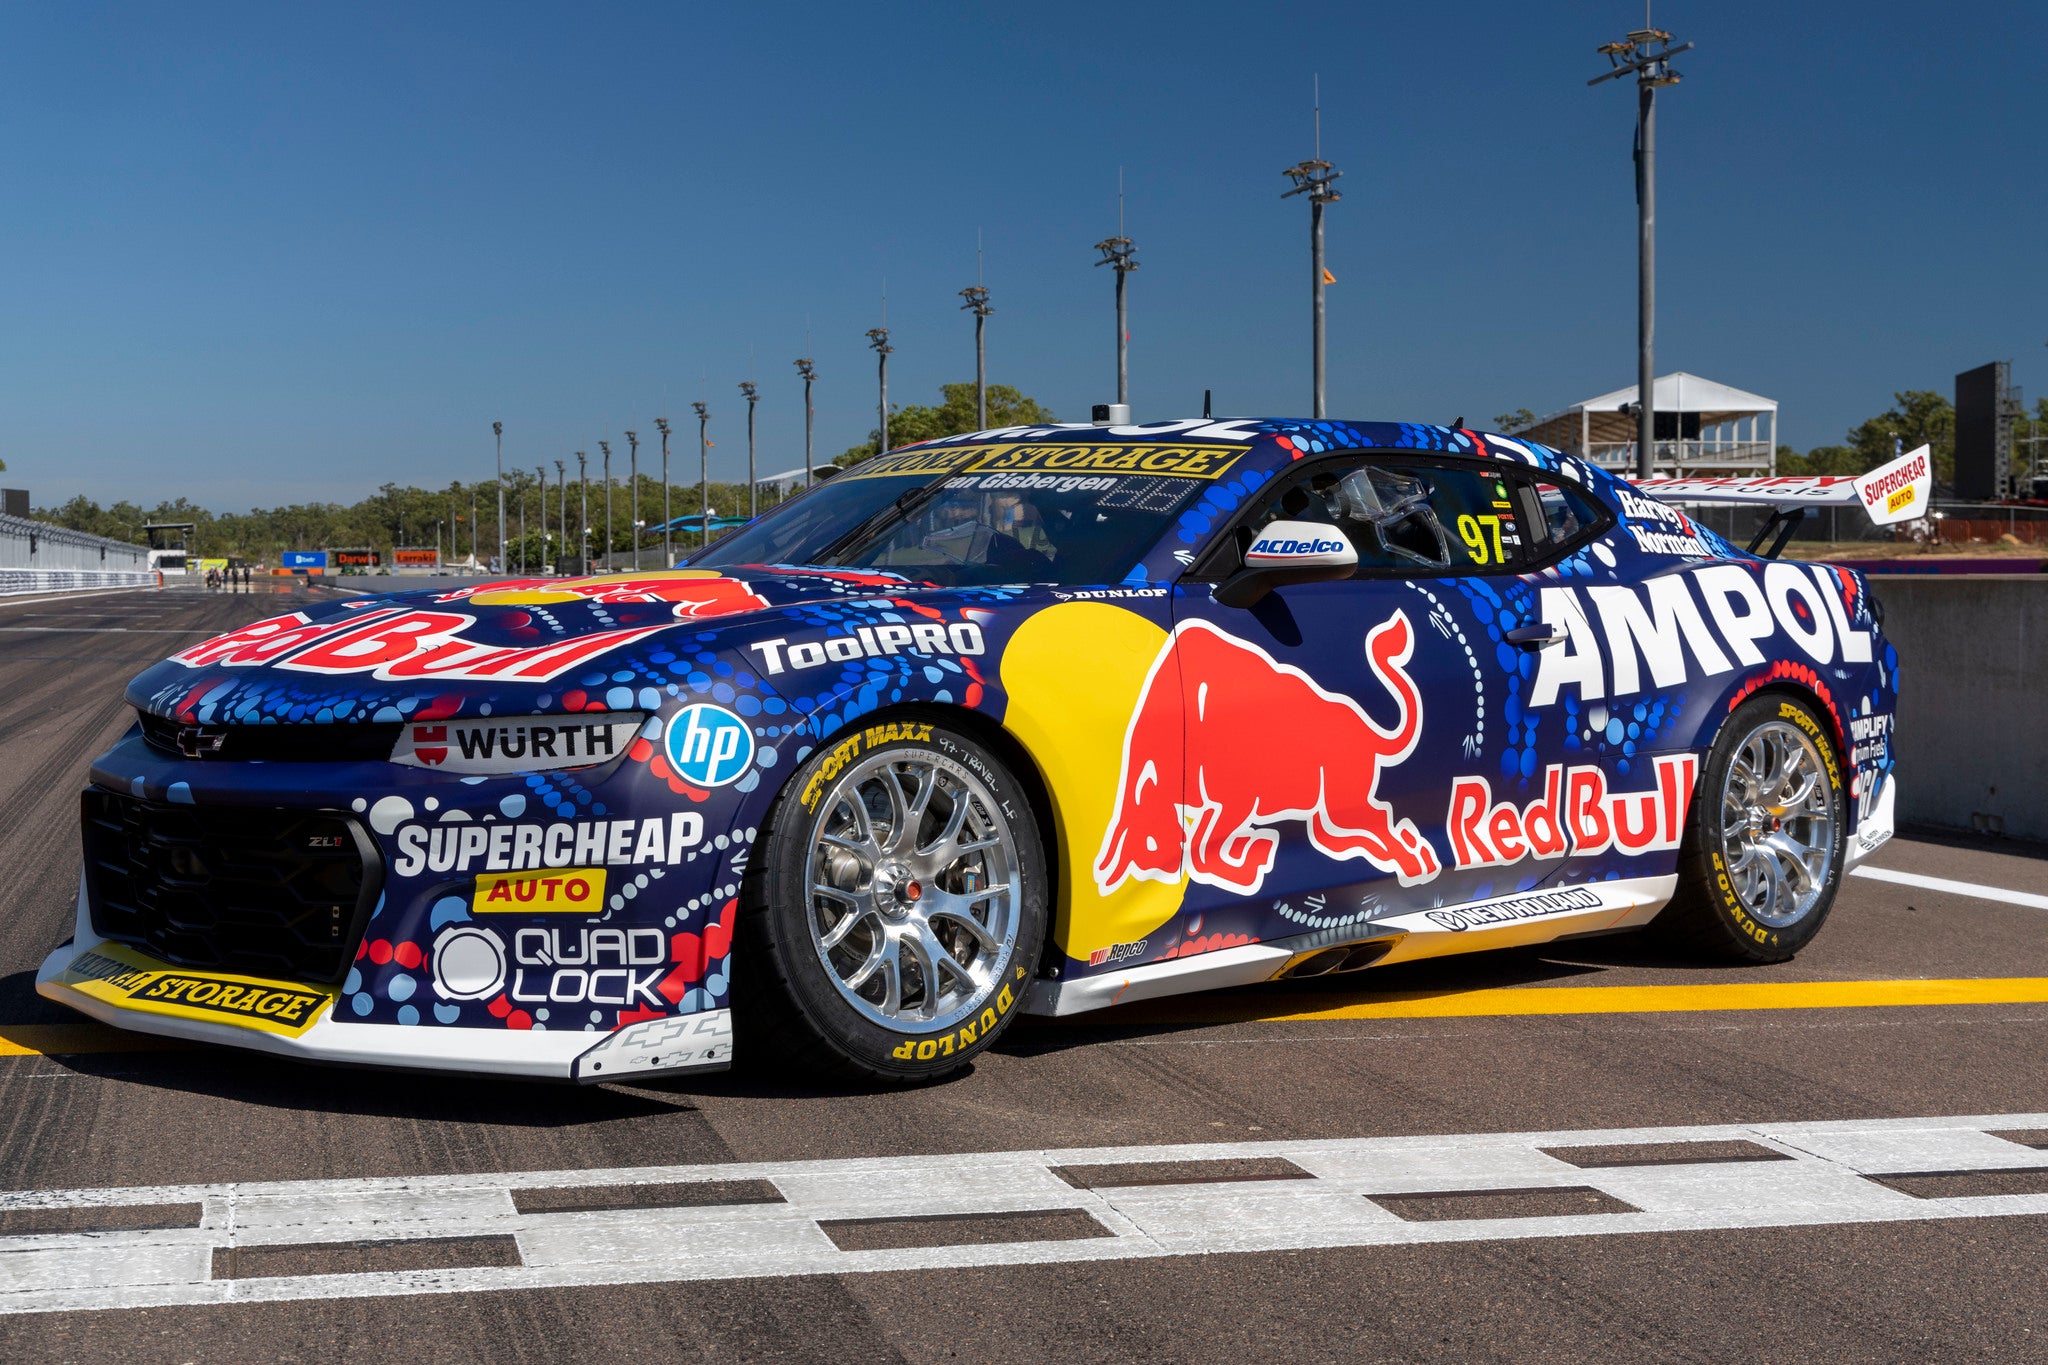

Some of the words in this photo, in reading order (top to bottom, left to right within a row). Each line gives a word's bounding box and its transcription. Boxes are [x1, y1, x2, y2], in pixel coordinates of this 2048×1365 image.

[990, 445, 1230, 474] STORAGE
[978, 473, 1119, 493] Gisbergen
[1705, 485, 1833, 497] Fuels
[1864, 455, 1927, 506] SUPERCHEAP
[1889, 489, 1914, 510] AUTO
[1614, 489, 1684, 530] Harvey
[339, 554, 378, 563] Darwin
[1252, 538, 1344, 554] ACDelco
[1457, 514, 1505, 565] 97
[1628, 525, 1710, 556] Norman
[1073, 588, 1168, 600] DUNLOP
[169, 612, 412, 668] Red
[273, 610, 662, 683] Bull
[751, 622, 986, 675] ToolPRO
[1529, 562, 1873, 708] AMPOL
[455, 723, 614, 760] WÜRTH
[680, 704, 741, 786] hp
[1778, 702, 1820, 736] SPORT
[1814, 733, 1843, 790] MAXX
[801, 734, 861, 815] SPORT
[866, 722, 935, 750] MAXX
[904, 750, 969, 780] SUPERCARS
[1448, 767, 1567, 868] Red
[1567, 757, 1696, 852] Bull
[309, 836, 343, 847] ZL1
[394, 811, 704, 878] SUPERCHEAP
[486, 878, 591, 903] AUTO
[1458, 901, 1516, 926] NEW
[1508, 887, 1603, 920] HOLLAND
[1711, 851, 1769, 945] DUNLOP
[514, 928, 666, 967] QUAD
[1107, 940, 1147, 962] Repco
[72, 952, 152, 992] NATIONAL
[144, 977, 317, 1022] STORAGE
[511, 968, 666, 1007] LOCK
[892, 982, 1015, 1061] DUNLOP
